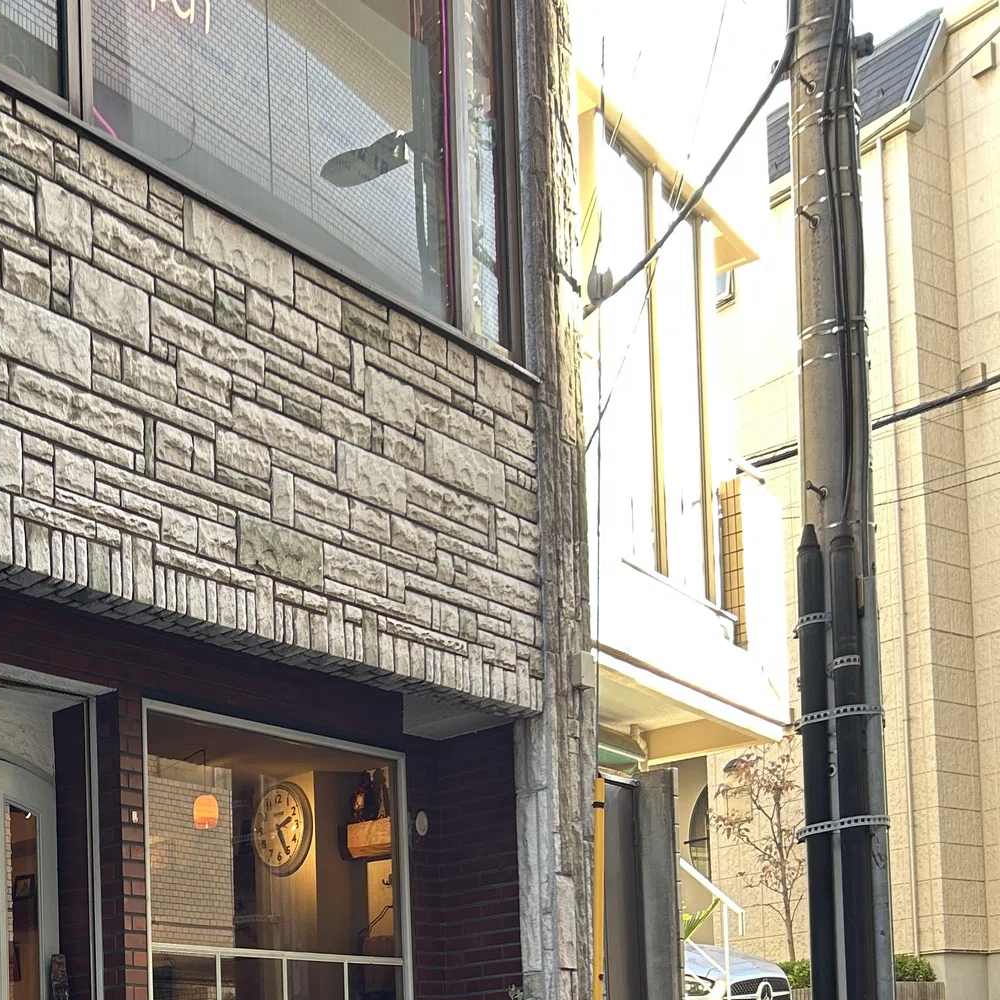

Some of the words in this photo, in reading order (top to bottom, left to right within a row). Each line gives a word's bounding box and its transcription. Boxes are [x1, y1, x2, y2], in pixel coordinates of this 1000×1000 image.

[261, 840, 267, 849] 8
[268, 849, 274, 859] 7
[277, 852, 282, 861] 6
